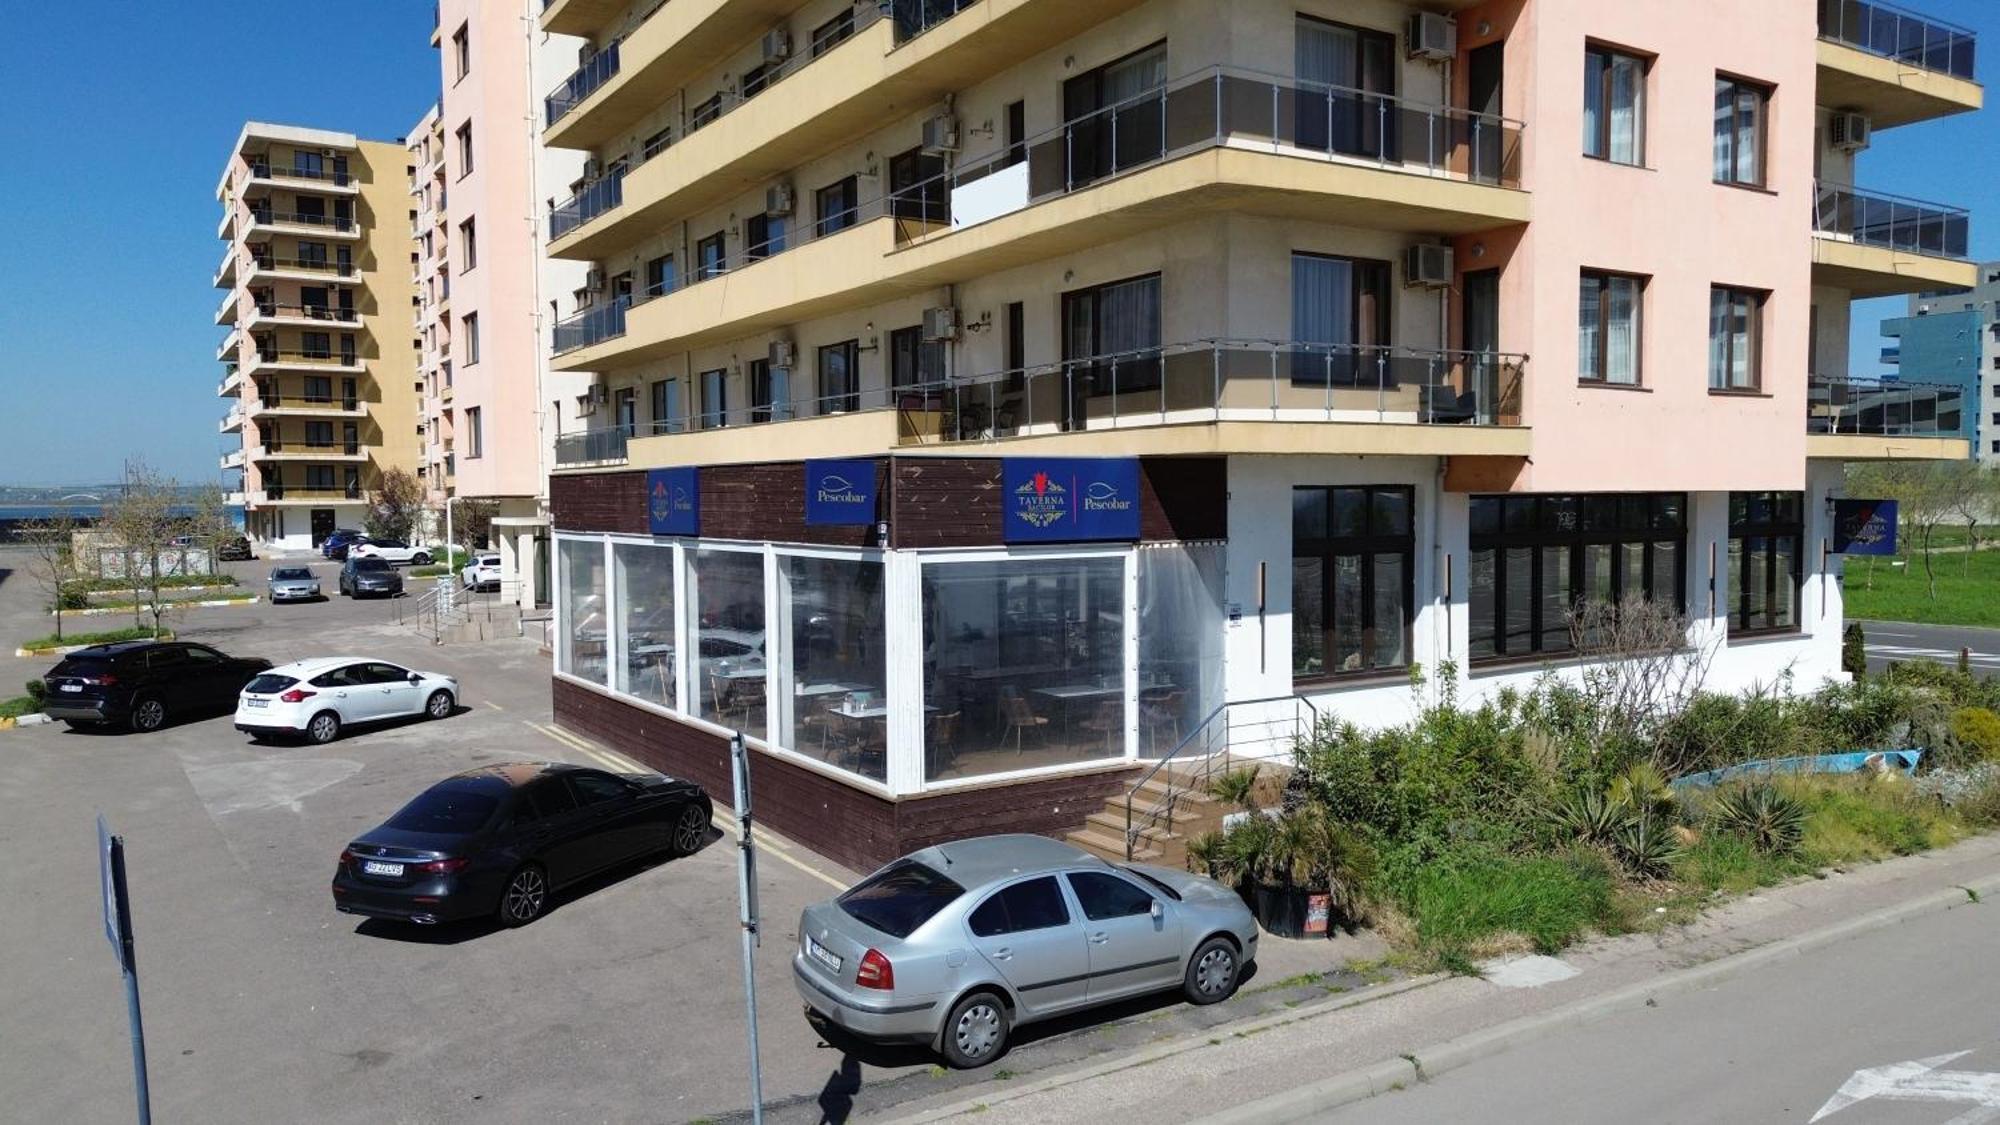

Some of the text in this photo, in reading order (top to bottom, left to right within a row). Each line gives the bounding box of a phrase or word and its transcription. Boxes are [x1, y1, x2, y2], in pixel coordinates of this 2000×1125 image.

[818, 490, 866, 502] Pescobar
[1019, 496, 1064, 505] TAVERNA
[1084, 497, 1130, 510] Pescobar
